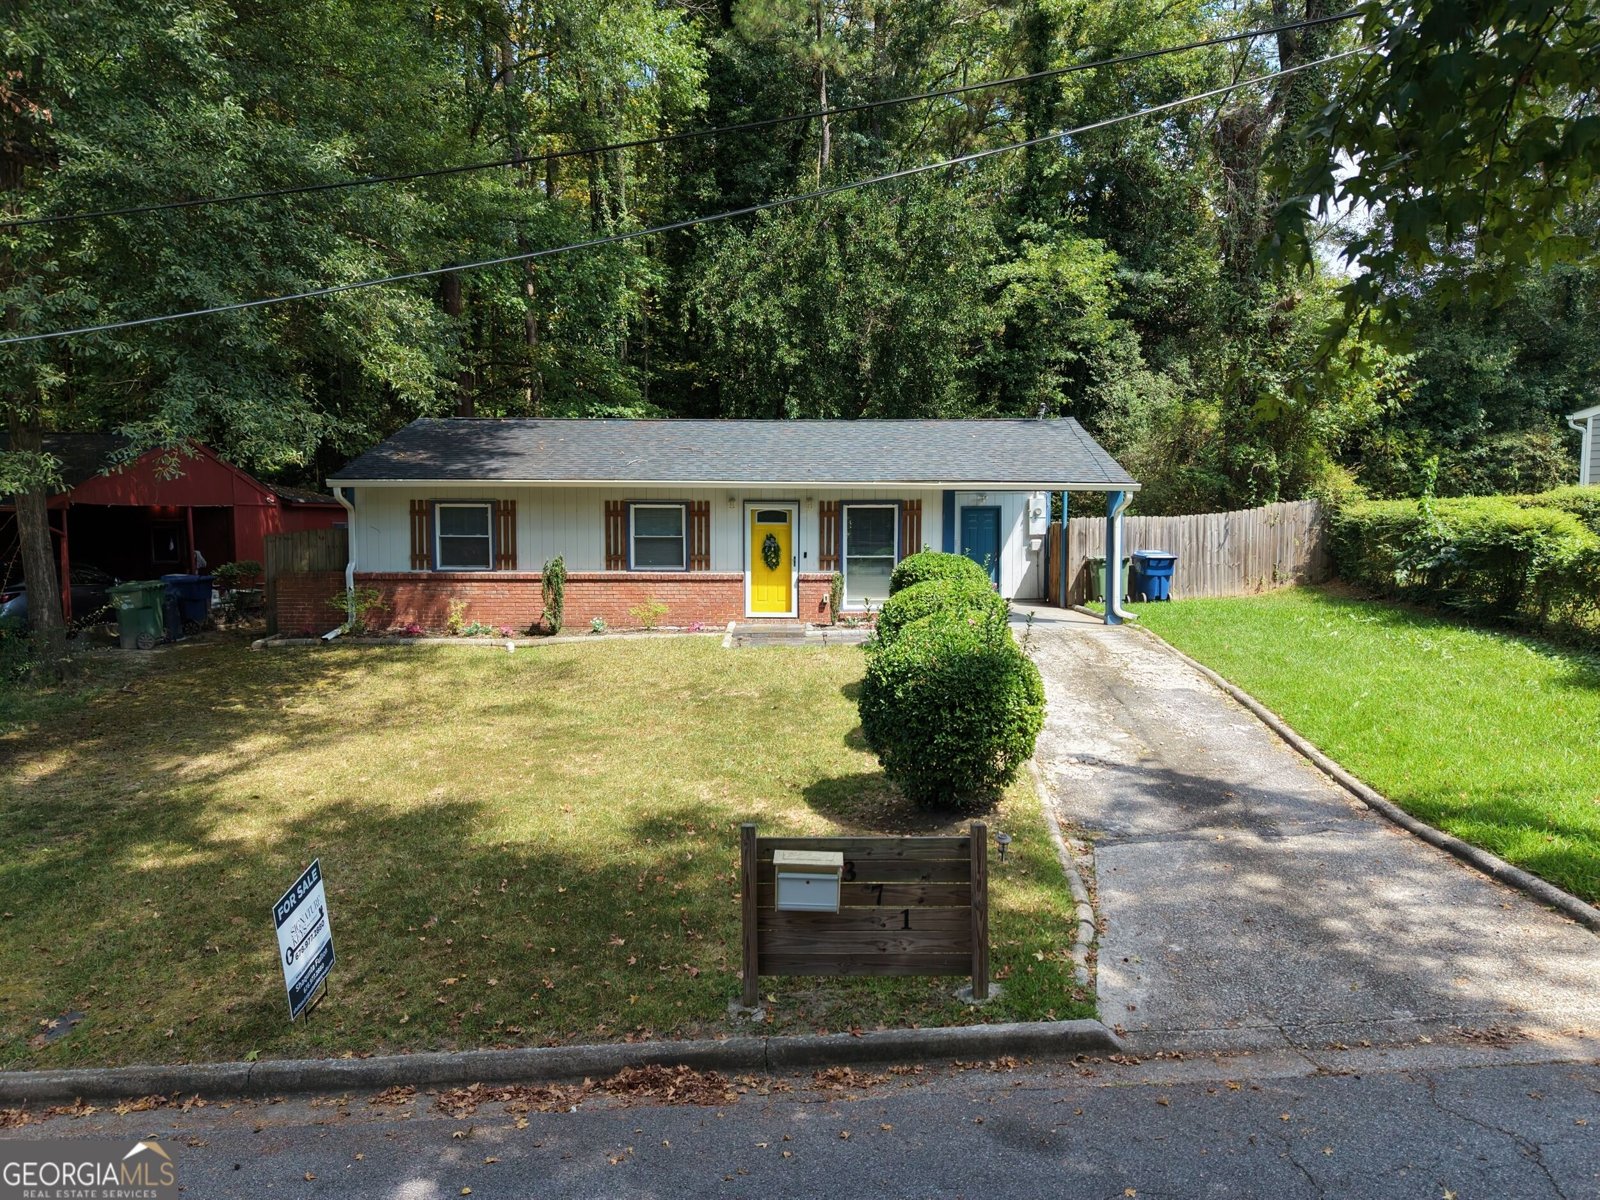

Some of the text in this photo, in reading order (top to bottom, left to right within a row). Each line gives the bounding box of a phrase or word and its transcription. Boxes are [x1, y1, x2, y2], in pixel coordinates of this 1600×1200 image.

[277, 893, 297, 921] FOR
[296, 867, 318, 899] SALE
[291, 895, 321, 937] SIGNATURE
[871, 884, 883, 906] 7
[900, 909, 912, 930] 1
